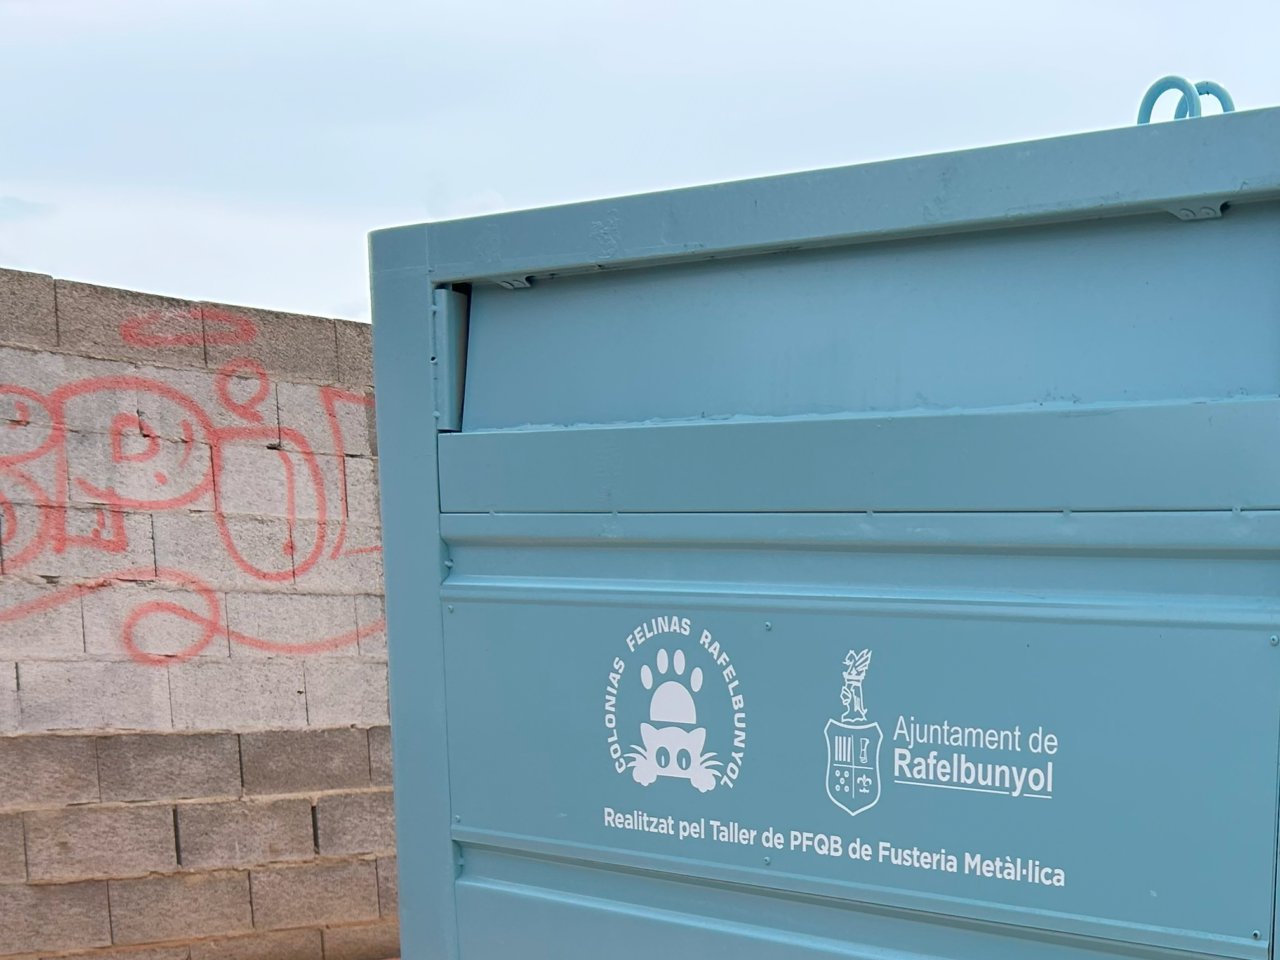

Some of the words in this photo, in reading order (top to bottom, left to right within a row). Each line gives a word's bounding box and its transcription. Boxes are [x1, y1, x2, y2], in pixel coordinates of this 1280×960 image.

[604, 657, 626, 775] COLONIAS
[626, 615, 691, 653] FELINAS
[699, 629, 746, 789] RAFELBUNYOL
[893, 715, 1022, 752] Ajuntament
[1029, 726, 1059, 755] de
[894, 748, 1054, 797] Rafelbunyol
[603, 807, 675, 835] Realitzat
[678, 818, 705, 842] pel
[709, 820, 757, 846] Taller
[761, 827, 785, 850] de
[790, 830, 843, 857] PFQB
[848, 836, 873, 862] de
[878, 842, 958, 873] Fusteria
